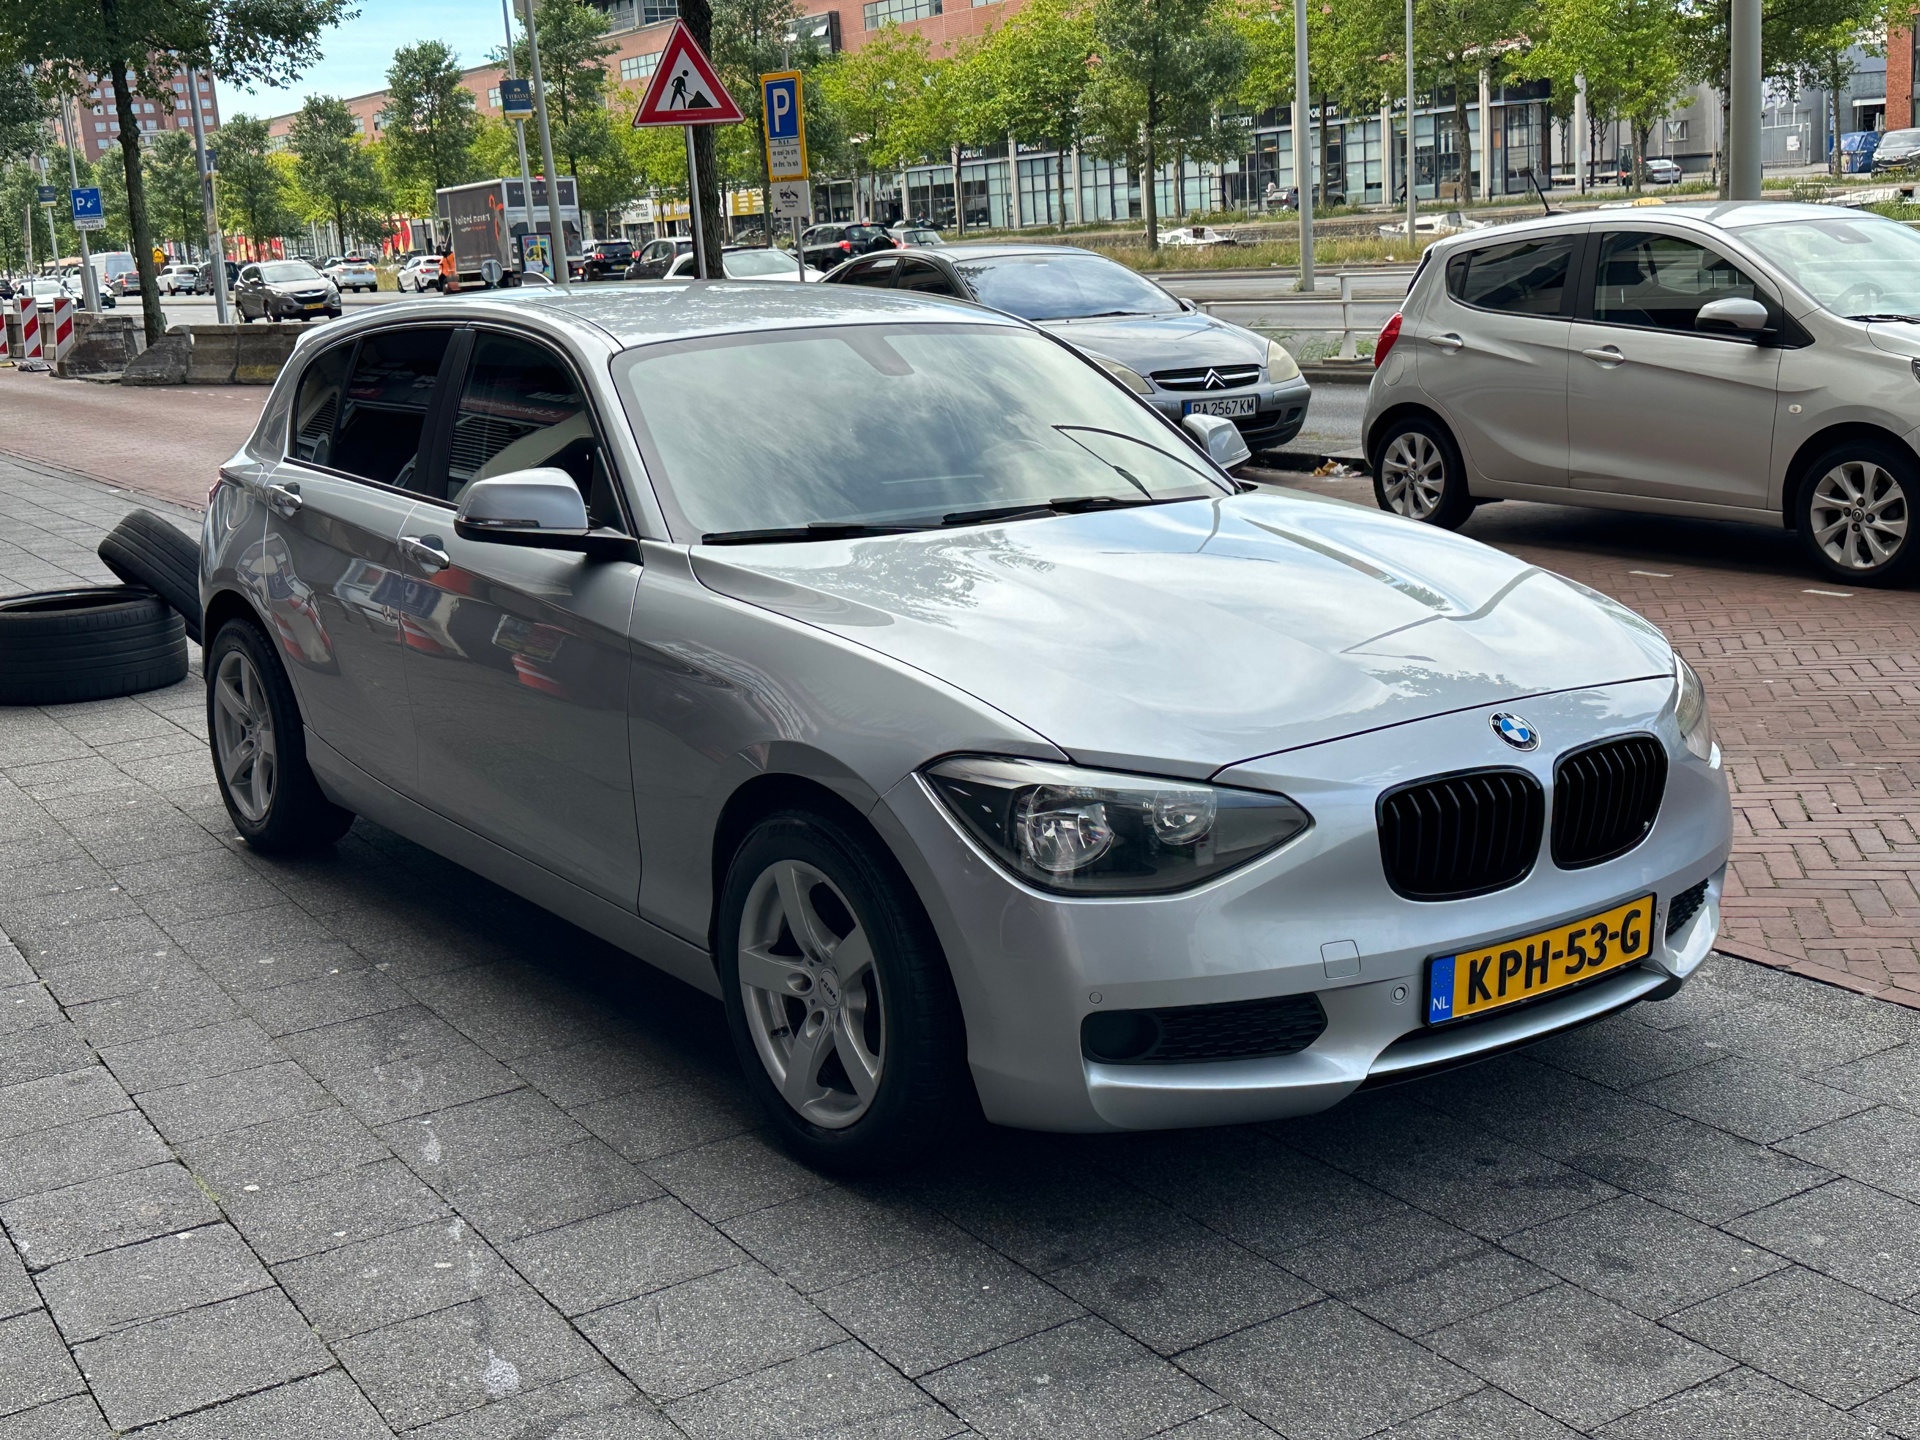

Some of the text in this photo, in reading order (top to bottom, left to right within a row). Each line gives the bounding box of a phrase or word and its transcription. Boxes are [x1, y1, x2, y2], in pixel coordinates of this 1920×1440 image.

[772, 88, 790, 133] P
[76, 197, 85, 211] P
[1211, 400, 1238, 416] 2567
[1240, 399, 1254, 414] KM
[1467, 909, 1642, 1005] KPH-53-G
[1432, 996, 1450, 1011] NL
